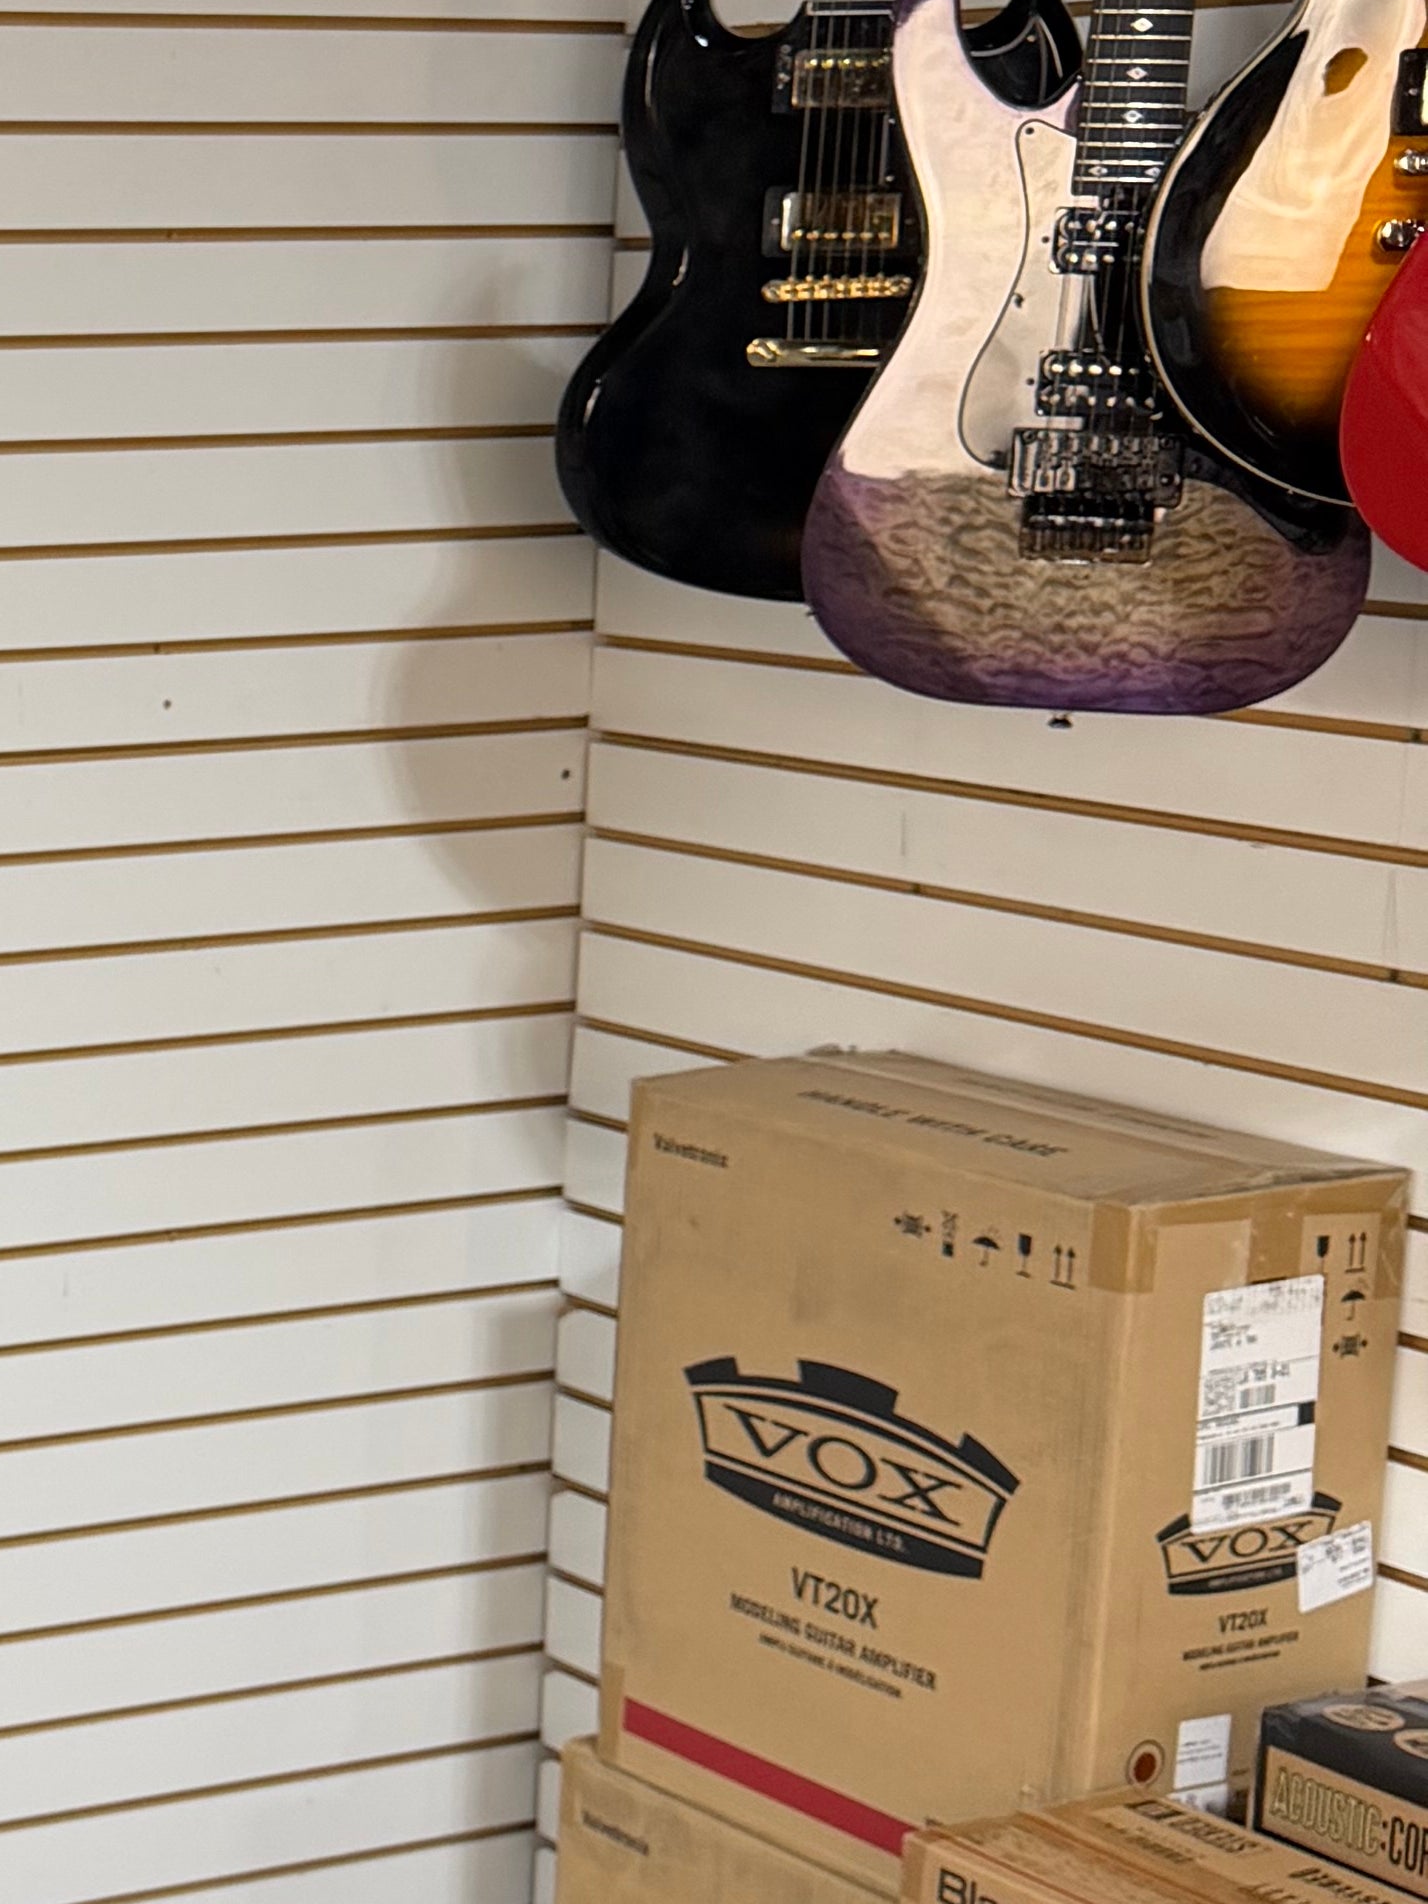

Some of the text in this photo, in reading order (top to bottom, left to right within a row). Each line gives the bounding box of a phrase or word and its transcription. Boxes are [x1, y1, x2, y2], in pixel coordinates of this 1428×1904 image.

[723, 1402, 964, 1527] VOX
[1181, 1520, 1313, 1564] VOX
[791, 1565, 879, 1631] VT20X
[1218, 1607, 1269, 1634] VT20X
[860, 1644, 938, 1691] AMPLIFIER
